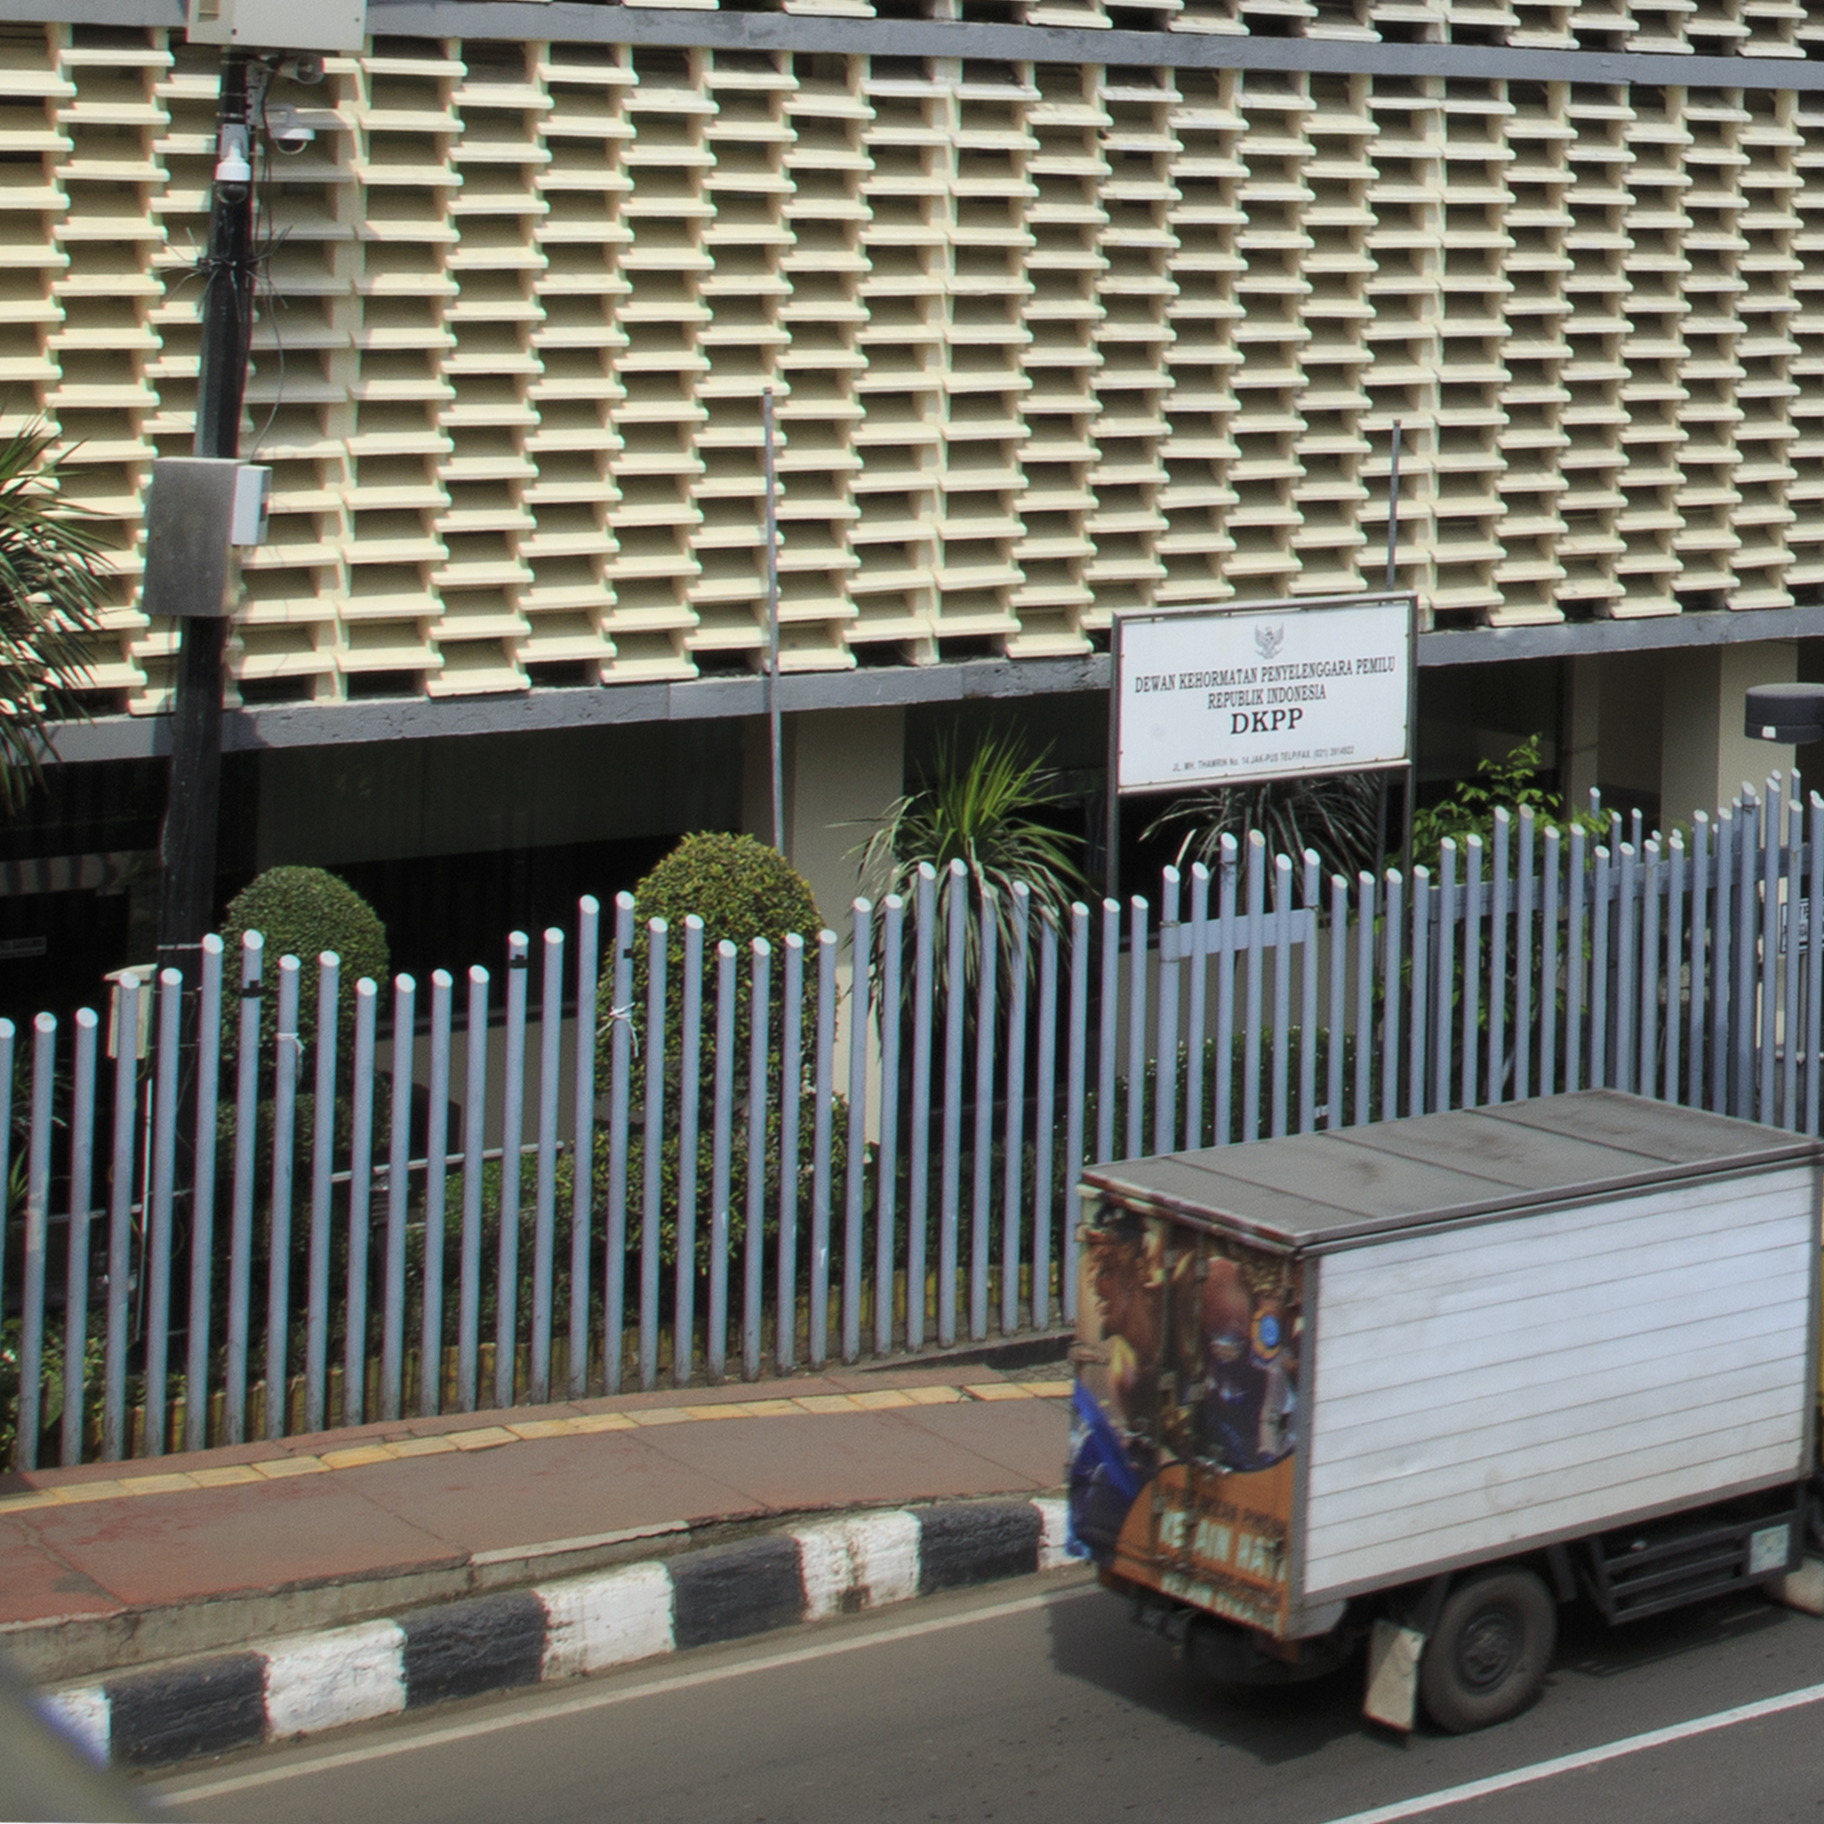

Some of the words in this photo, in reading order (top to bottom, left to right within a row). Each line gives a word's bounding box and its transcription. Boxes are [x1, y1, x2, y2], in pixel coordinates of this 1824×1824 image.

[1135, 675, 1176, 694] DEWAN
[1179, 666, 1258, 690] KEHORMATAN
[1261, 659, 1353, 683] PENYELENGGARA
[1355, 656, 1396, 676] PEMILU
[1207, 688, 1264, 710] REPUBLIK
[1266, 684, 1327, 704] INDONESIA
[1230, 707, 1304, 735] DKPP
